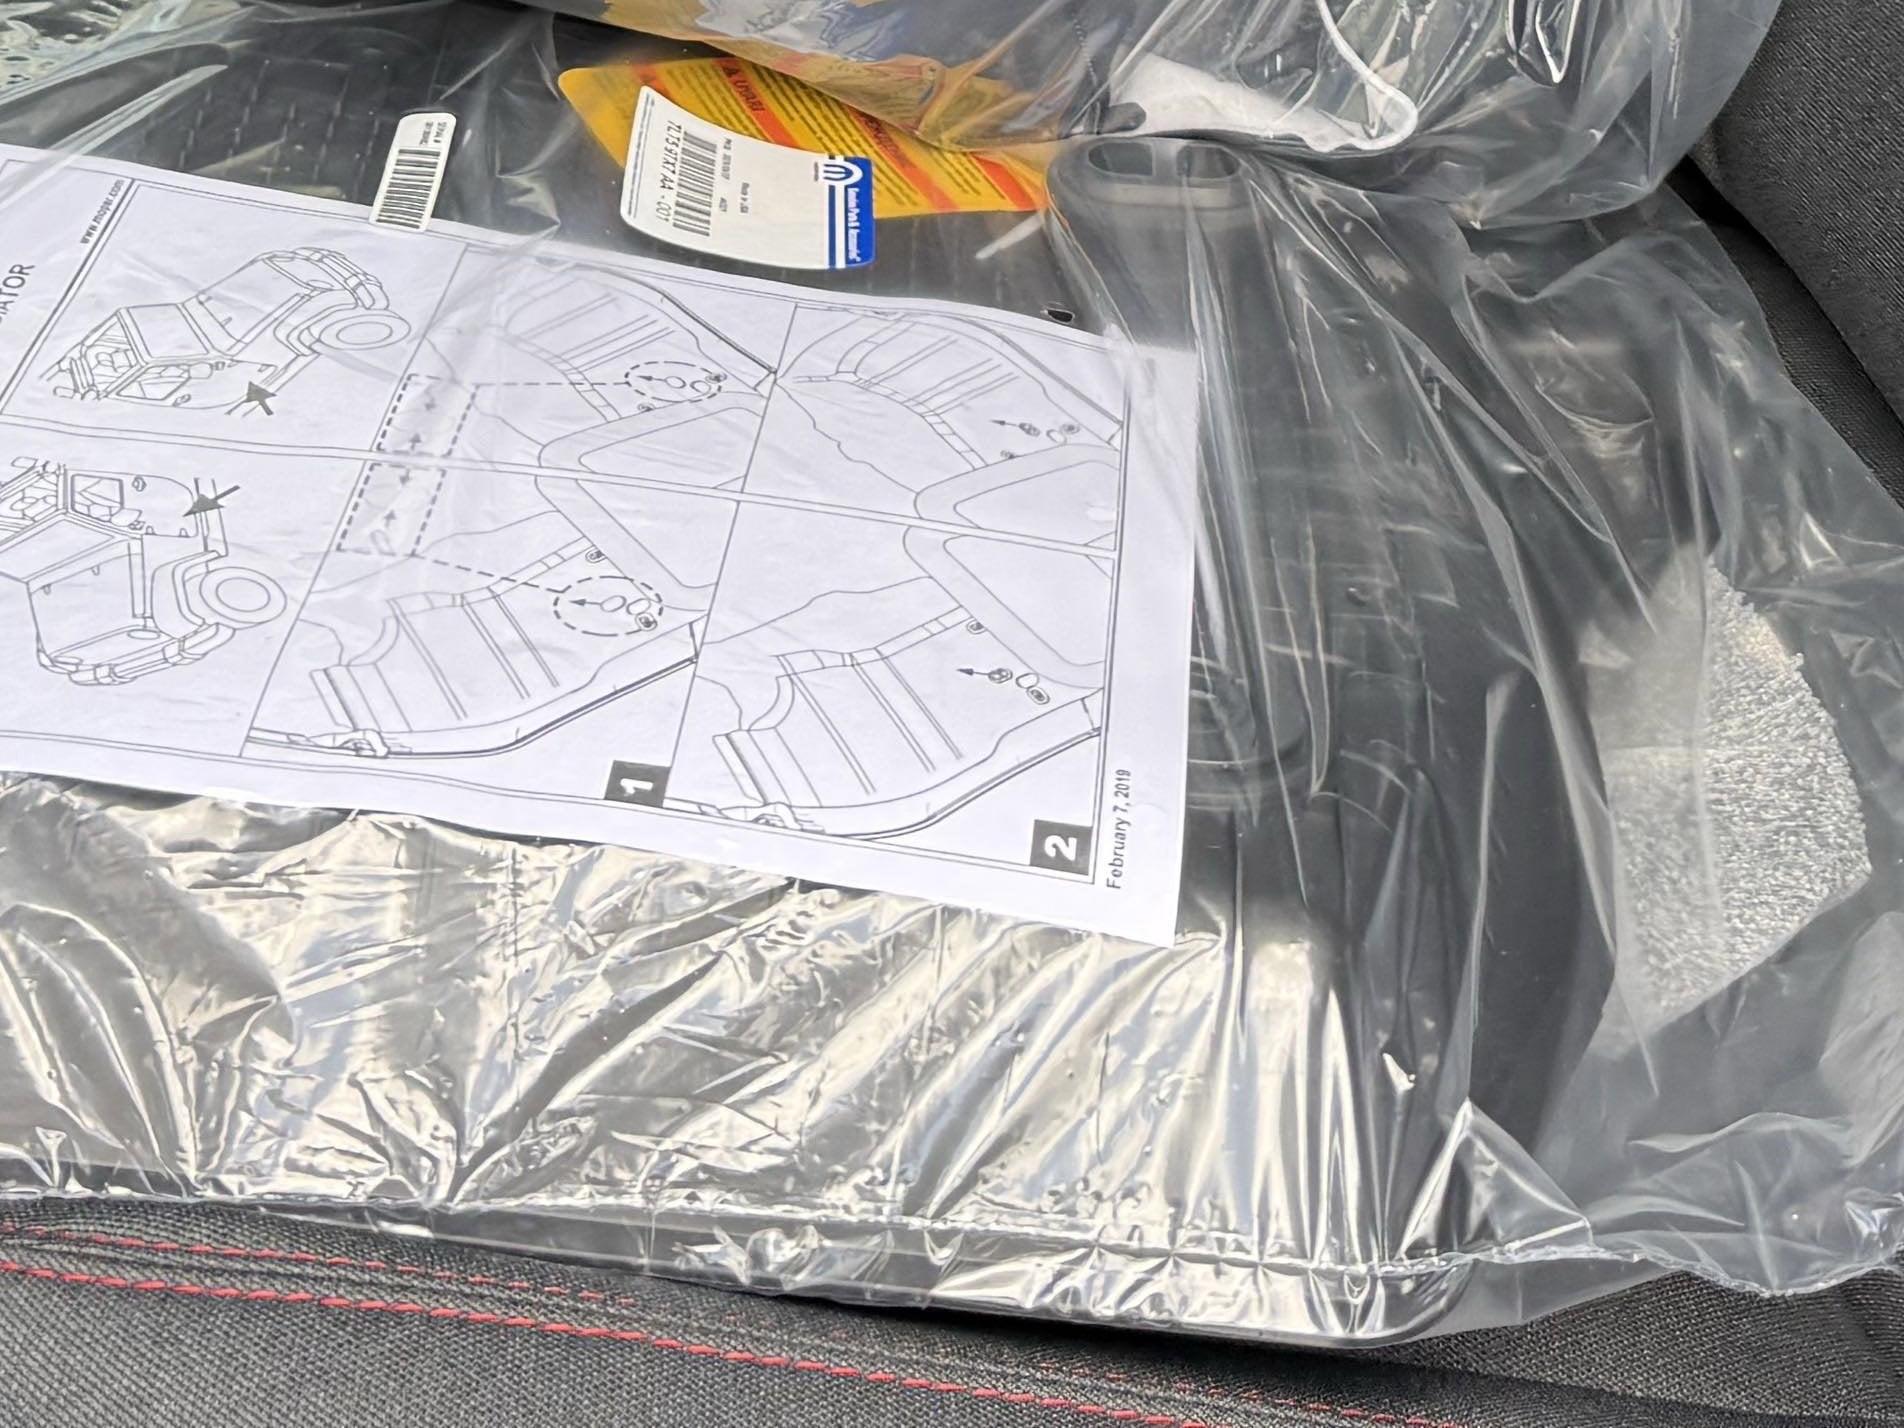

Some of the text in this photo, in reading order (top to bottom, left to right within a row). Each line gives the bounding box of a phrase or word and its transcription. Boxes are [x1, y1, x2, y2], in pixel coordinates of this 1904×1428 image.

[80, 179, 125, 244] www.mopar.com
[620, 777, 654, 796] 1
[1043, 834, 1078, 862] 2
[1105, 769, 1132, 890] February 7, 2019
